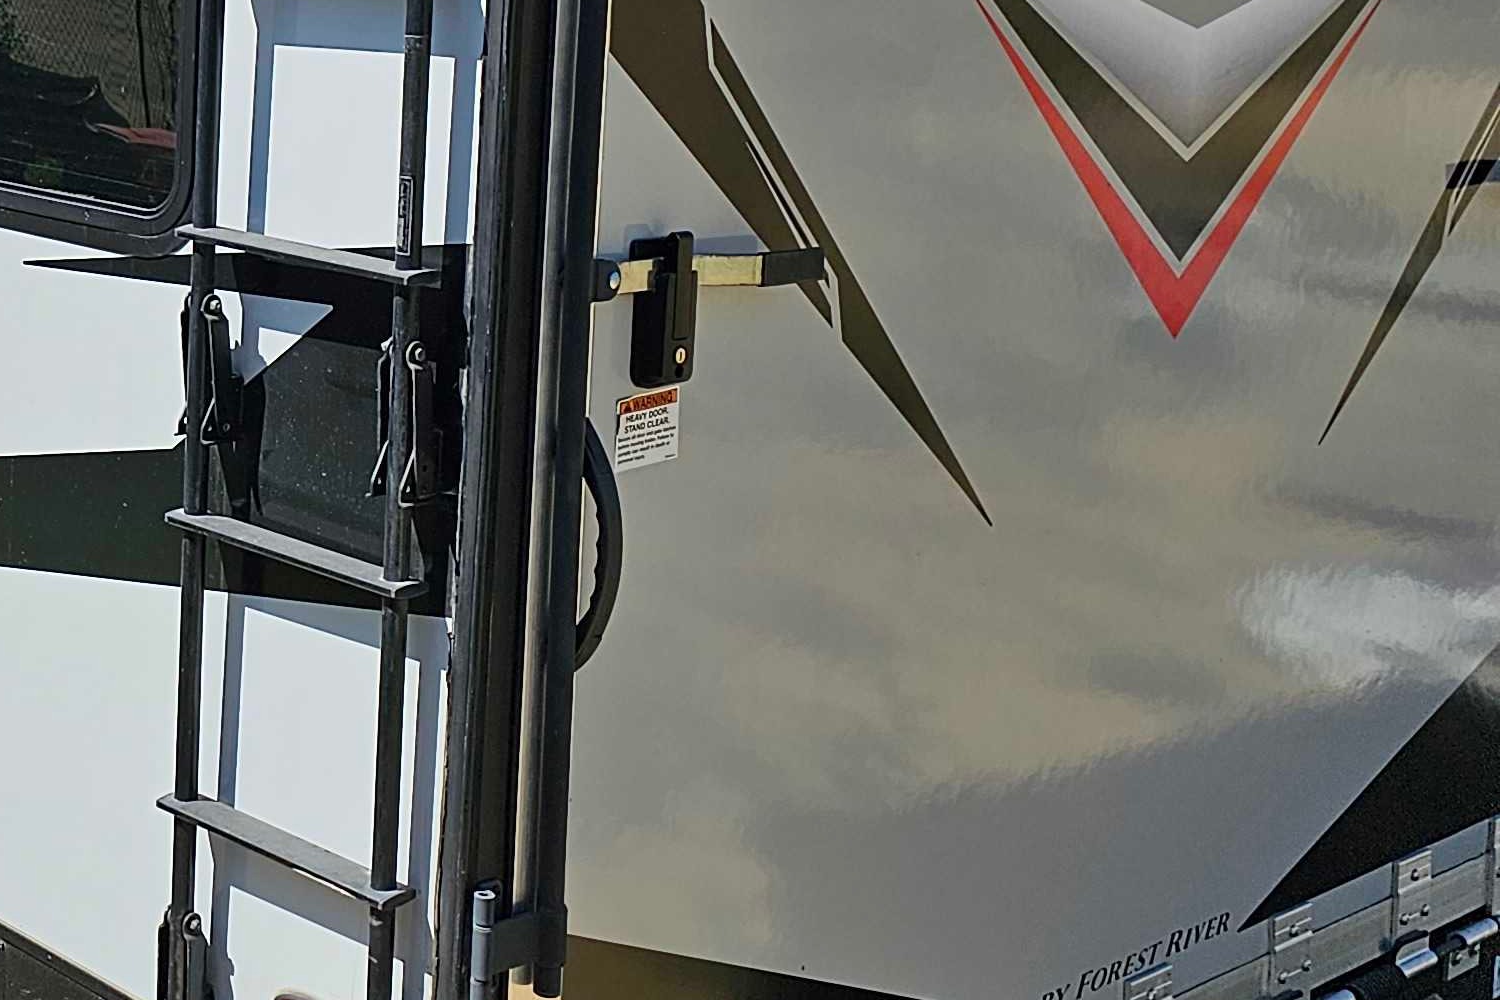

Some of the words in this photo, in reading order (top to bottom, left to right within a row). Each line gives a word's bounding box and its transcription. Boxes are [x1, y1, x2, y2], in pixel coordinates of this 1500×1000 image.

[633, 390, 674, 410] WARNING
[626, 413, 647, 424] HEAVY
[624, 422, 646, 434] STAND
[1076, 941, 1163, 1000] FOREST
[1165, 912, 1231, 958] RIVER
